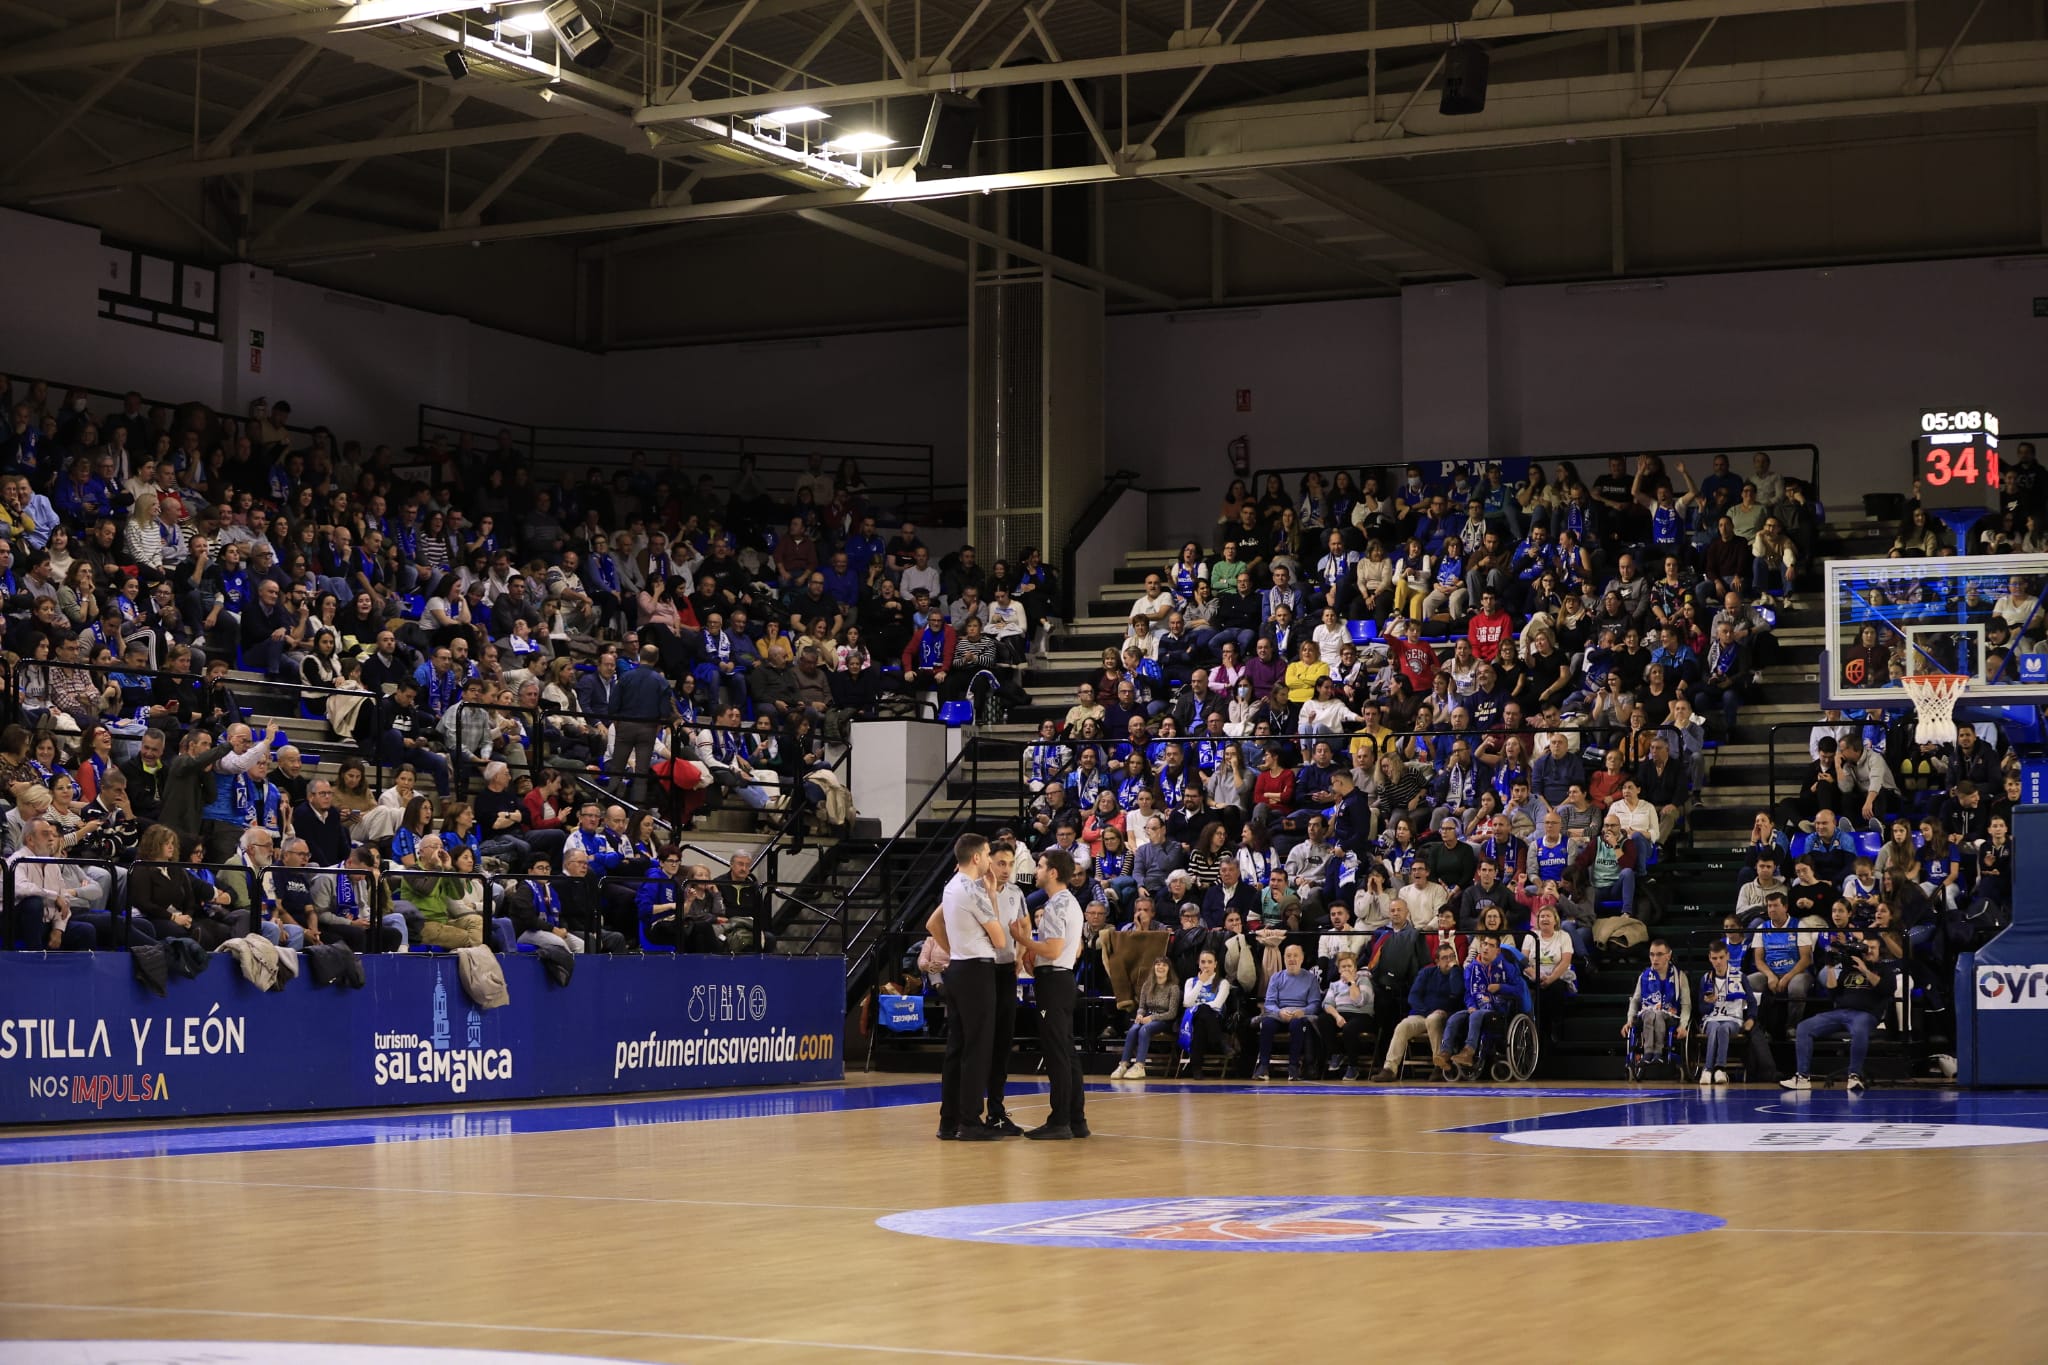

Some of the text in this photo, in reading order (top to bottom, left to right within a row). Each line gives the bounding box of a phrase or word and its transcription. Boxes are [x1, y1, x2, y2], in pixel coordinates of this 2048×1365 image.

[1921, 411, 1981, 431] 05:08
[1926, 447, 1979, 486] 34
[2031, 772, 2040, 804] MONDO
[130, 1018, 152, 1066] Y
[165, 1002, 245, 1056] LEÓN
[374, 1029, 419, 1050] turismo
[614, 1026, 833, 1079] perfumeriasavenida.com
[29, 1072, 170, 1110] NOS IMPULSA
